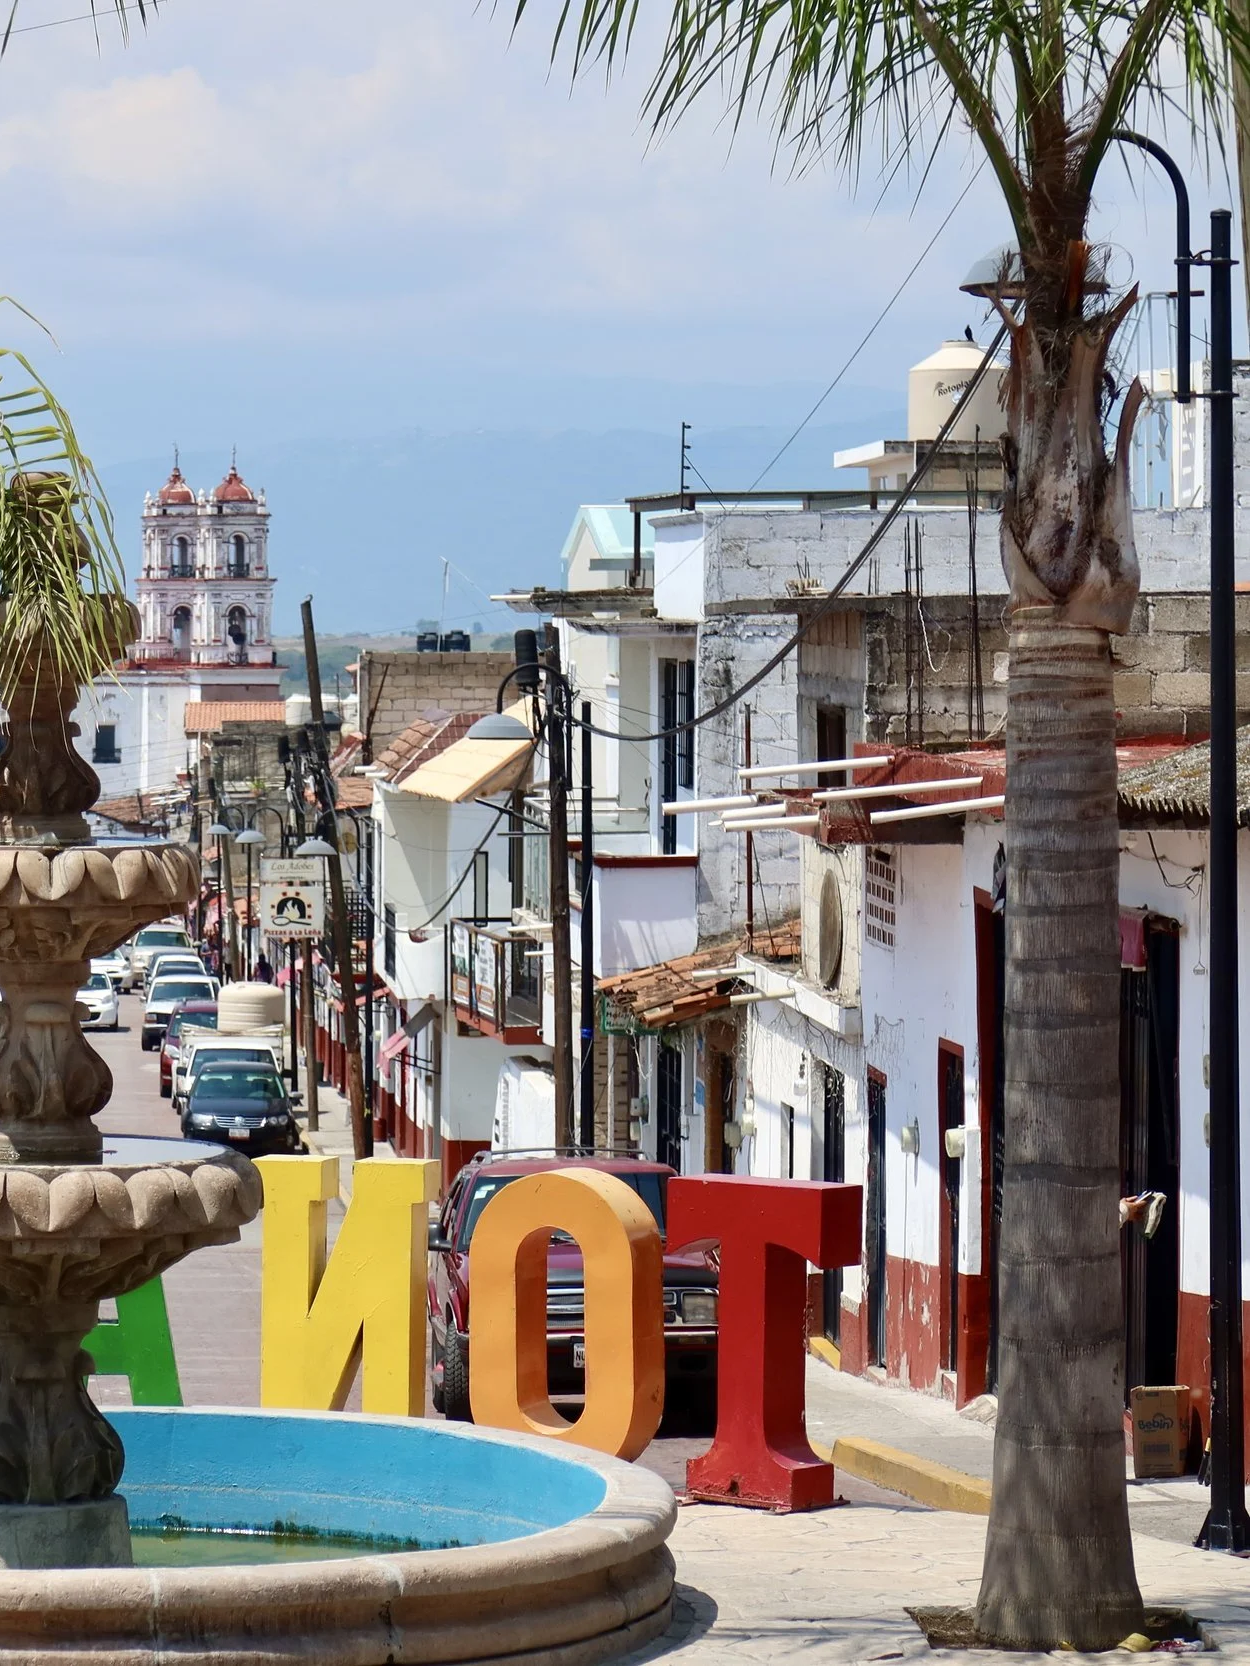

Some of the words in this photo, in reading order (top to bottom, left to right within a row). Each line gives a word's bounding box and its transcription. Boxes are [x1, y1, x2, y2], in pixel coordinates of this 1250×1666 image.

[937, 379, 972, 397] Rotopla
[271, 862, 285, 871] Los
[287, 861, 315, 871] Adobes
[1137, 1418, 1171, 1430] Bebin
